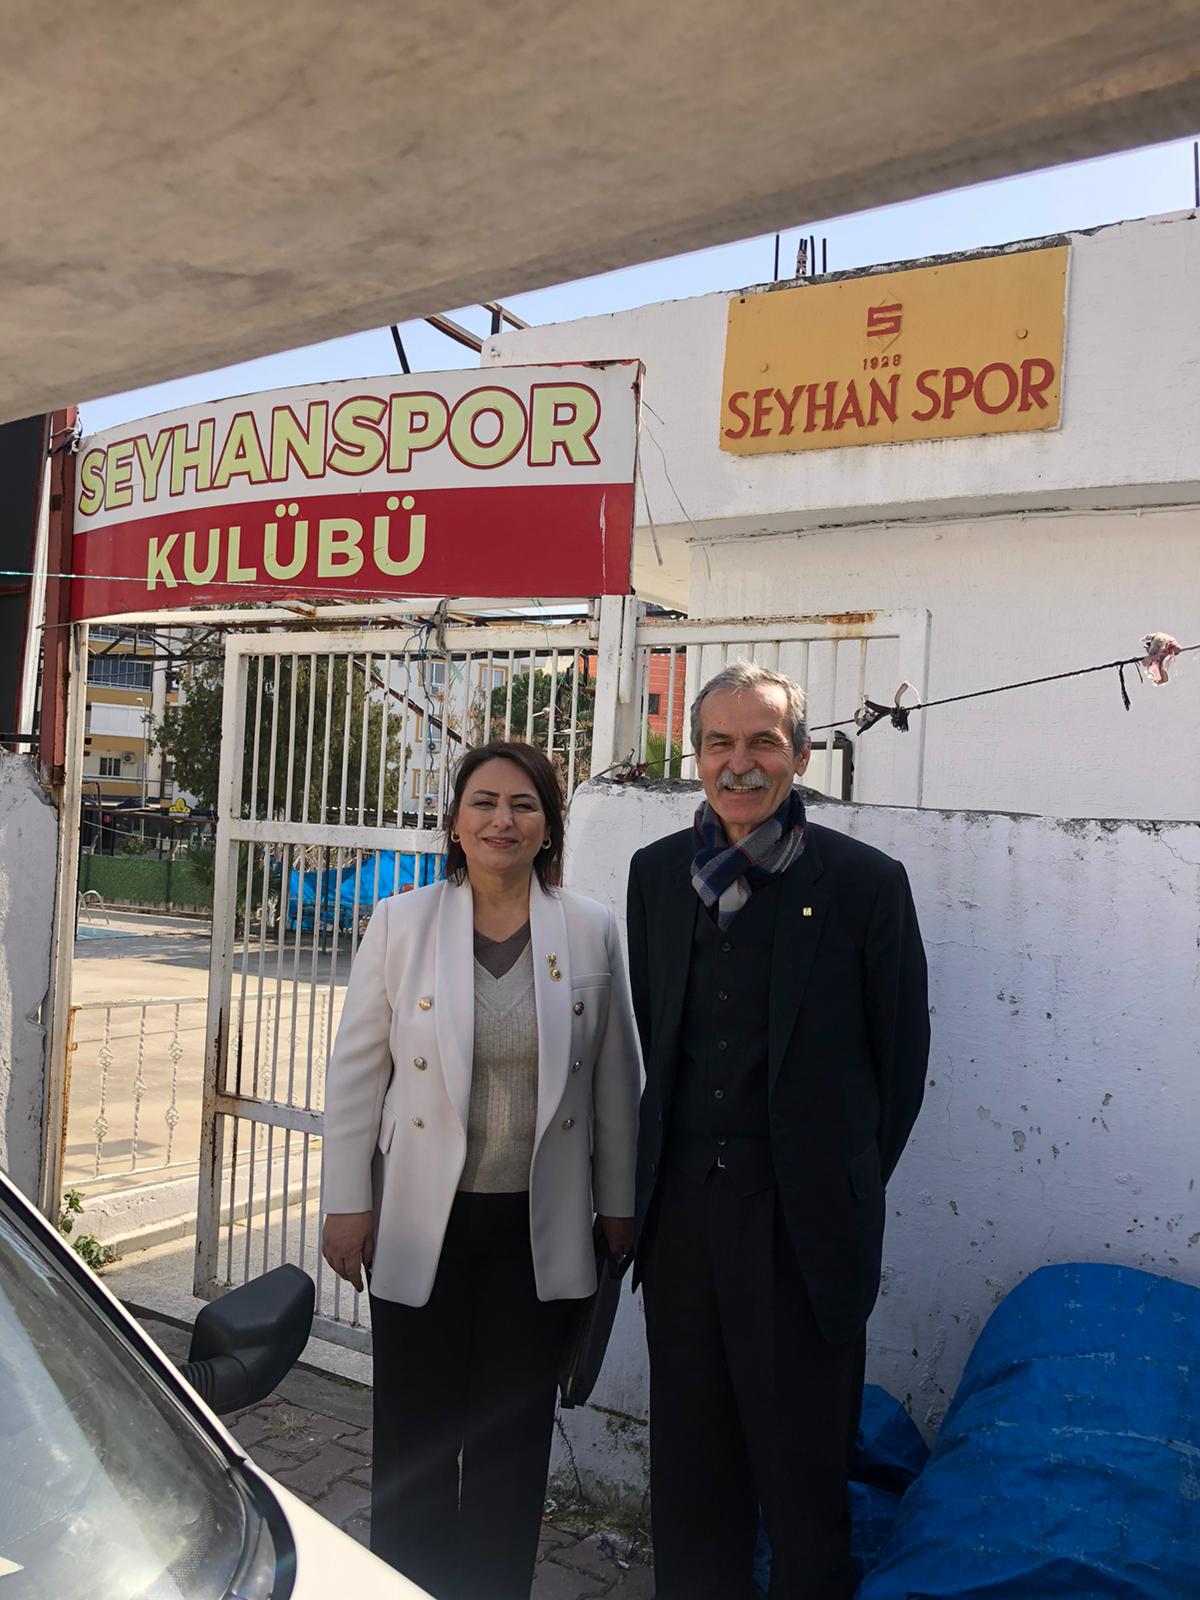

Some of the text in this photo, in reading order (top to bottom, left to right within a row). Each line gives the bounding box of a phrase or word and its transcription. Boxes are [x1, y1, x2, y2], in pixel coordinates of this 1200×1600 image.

[724, 358, 1055, 439] SEYHAN SPOR
[78, 382, 601, 516] SEYHANSPOR
[146, 495, 427, 591] KULÜBÜ
